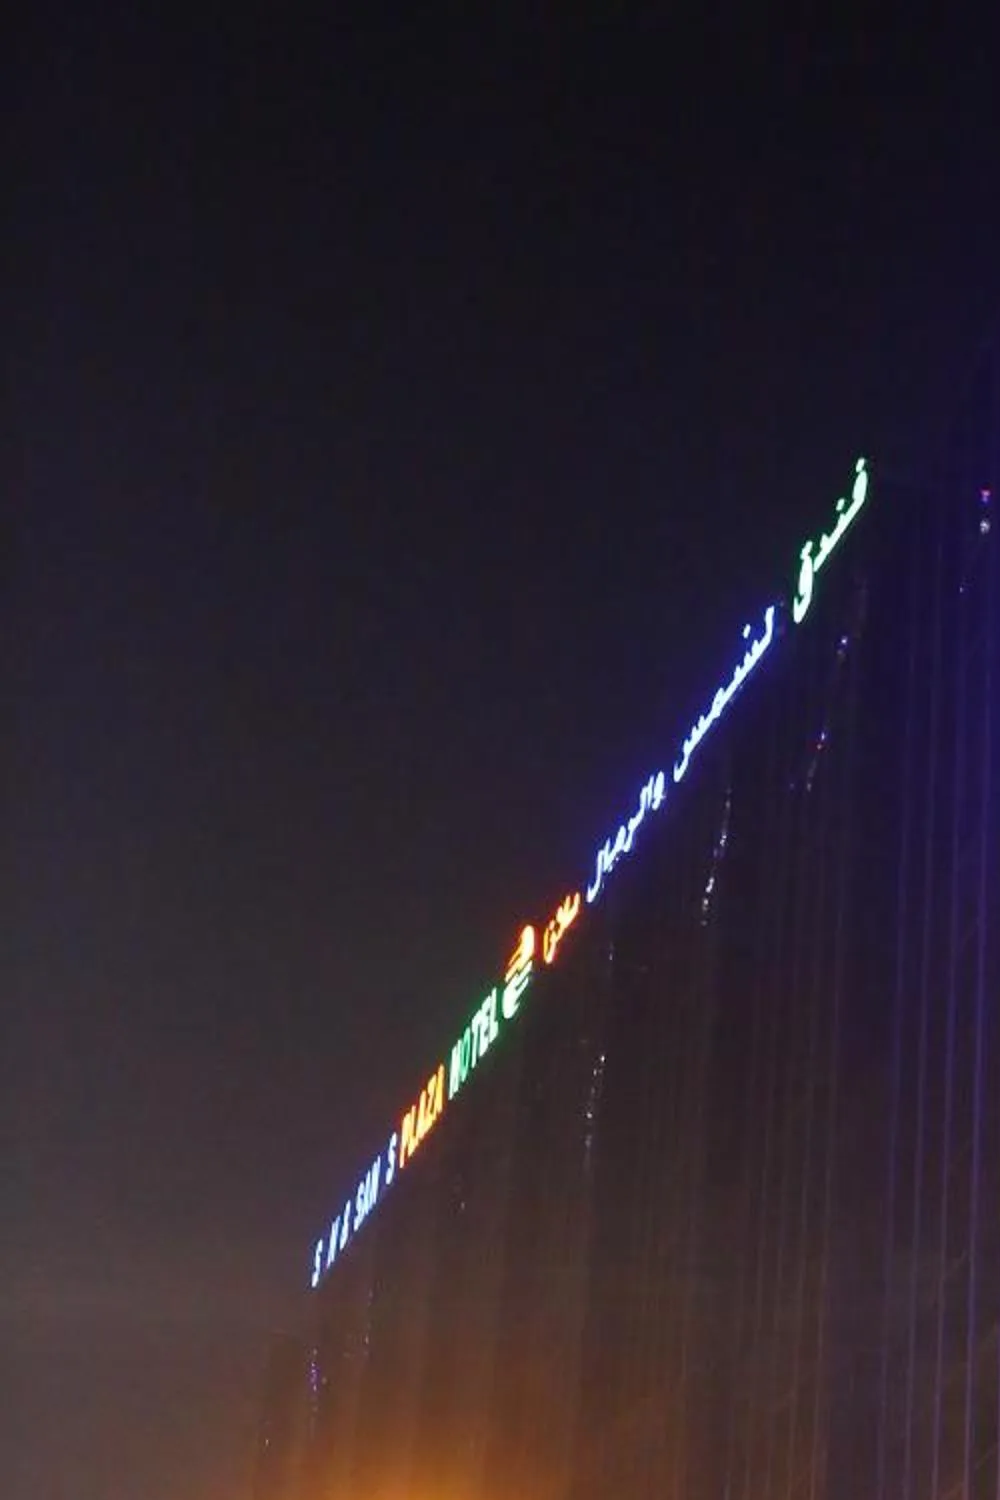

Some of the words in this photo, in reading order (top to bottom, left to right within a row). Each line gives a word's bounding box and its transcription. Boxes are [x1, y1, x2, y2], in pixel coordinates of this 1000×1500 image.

[353, 1132, 397, 1232] SANS
[400, 1063, 446, 1170] PLAZA
[449, 987, 499, 1100] HOTEL
